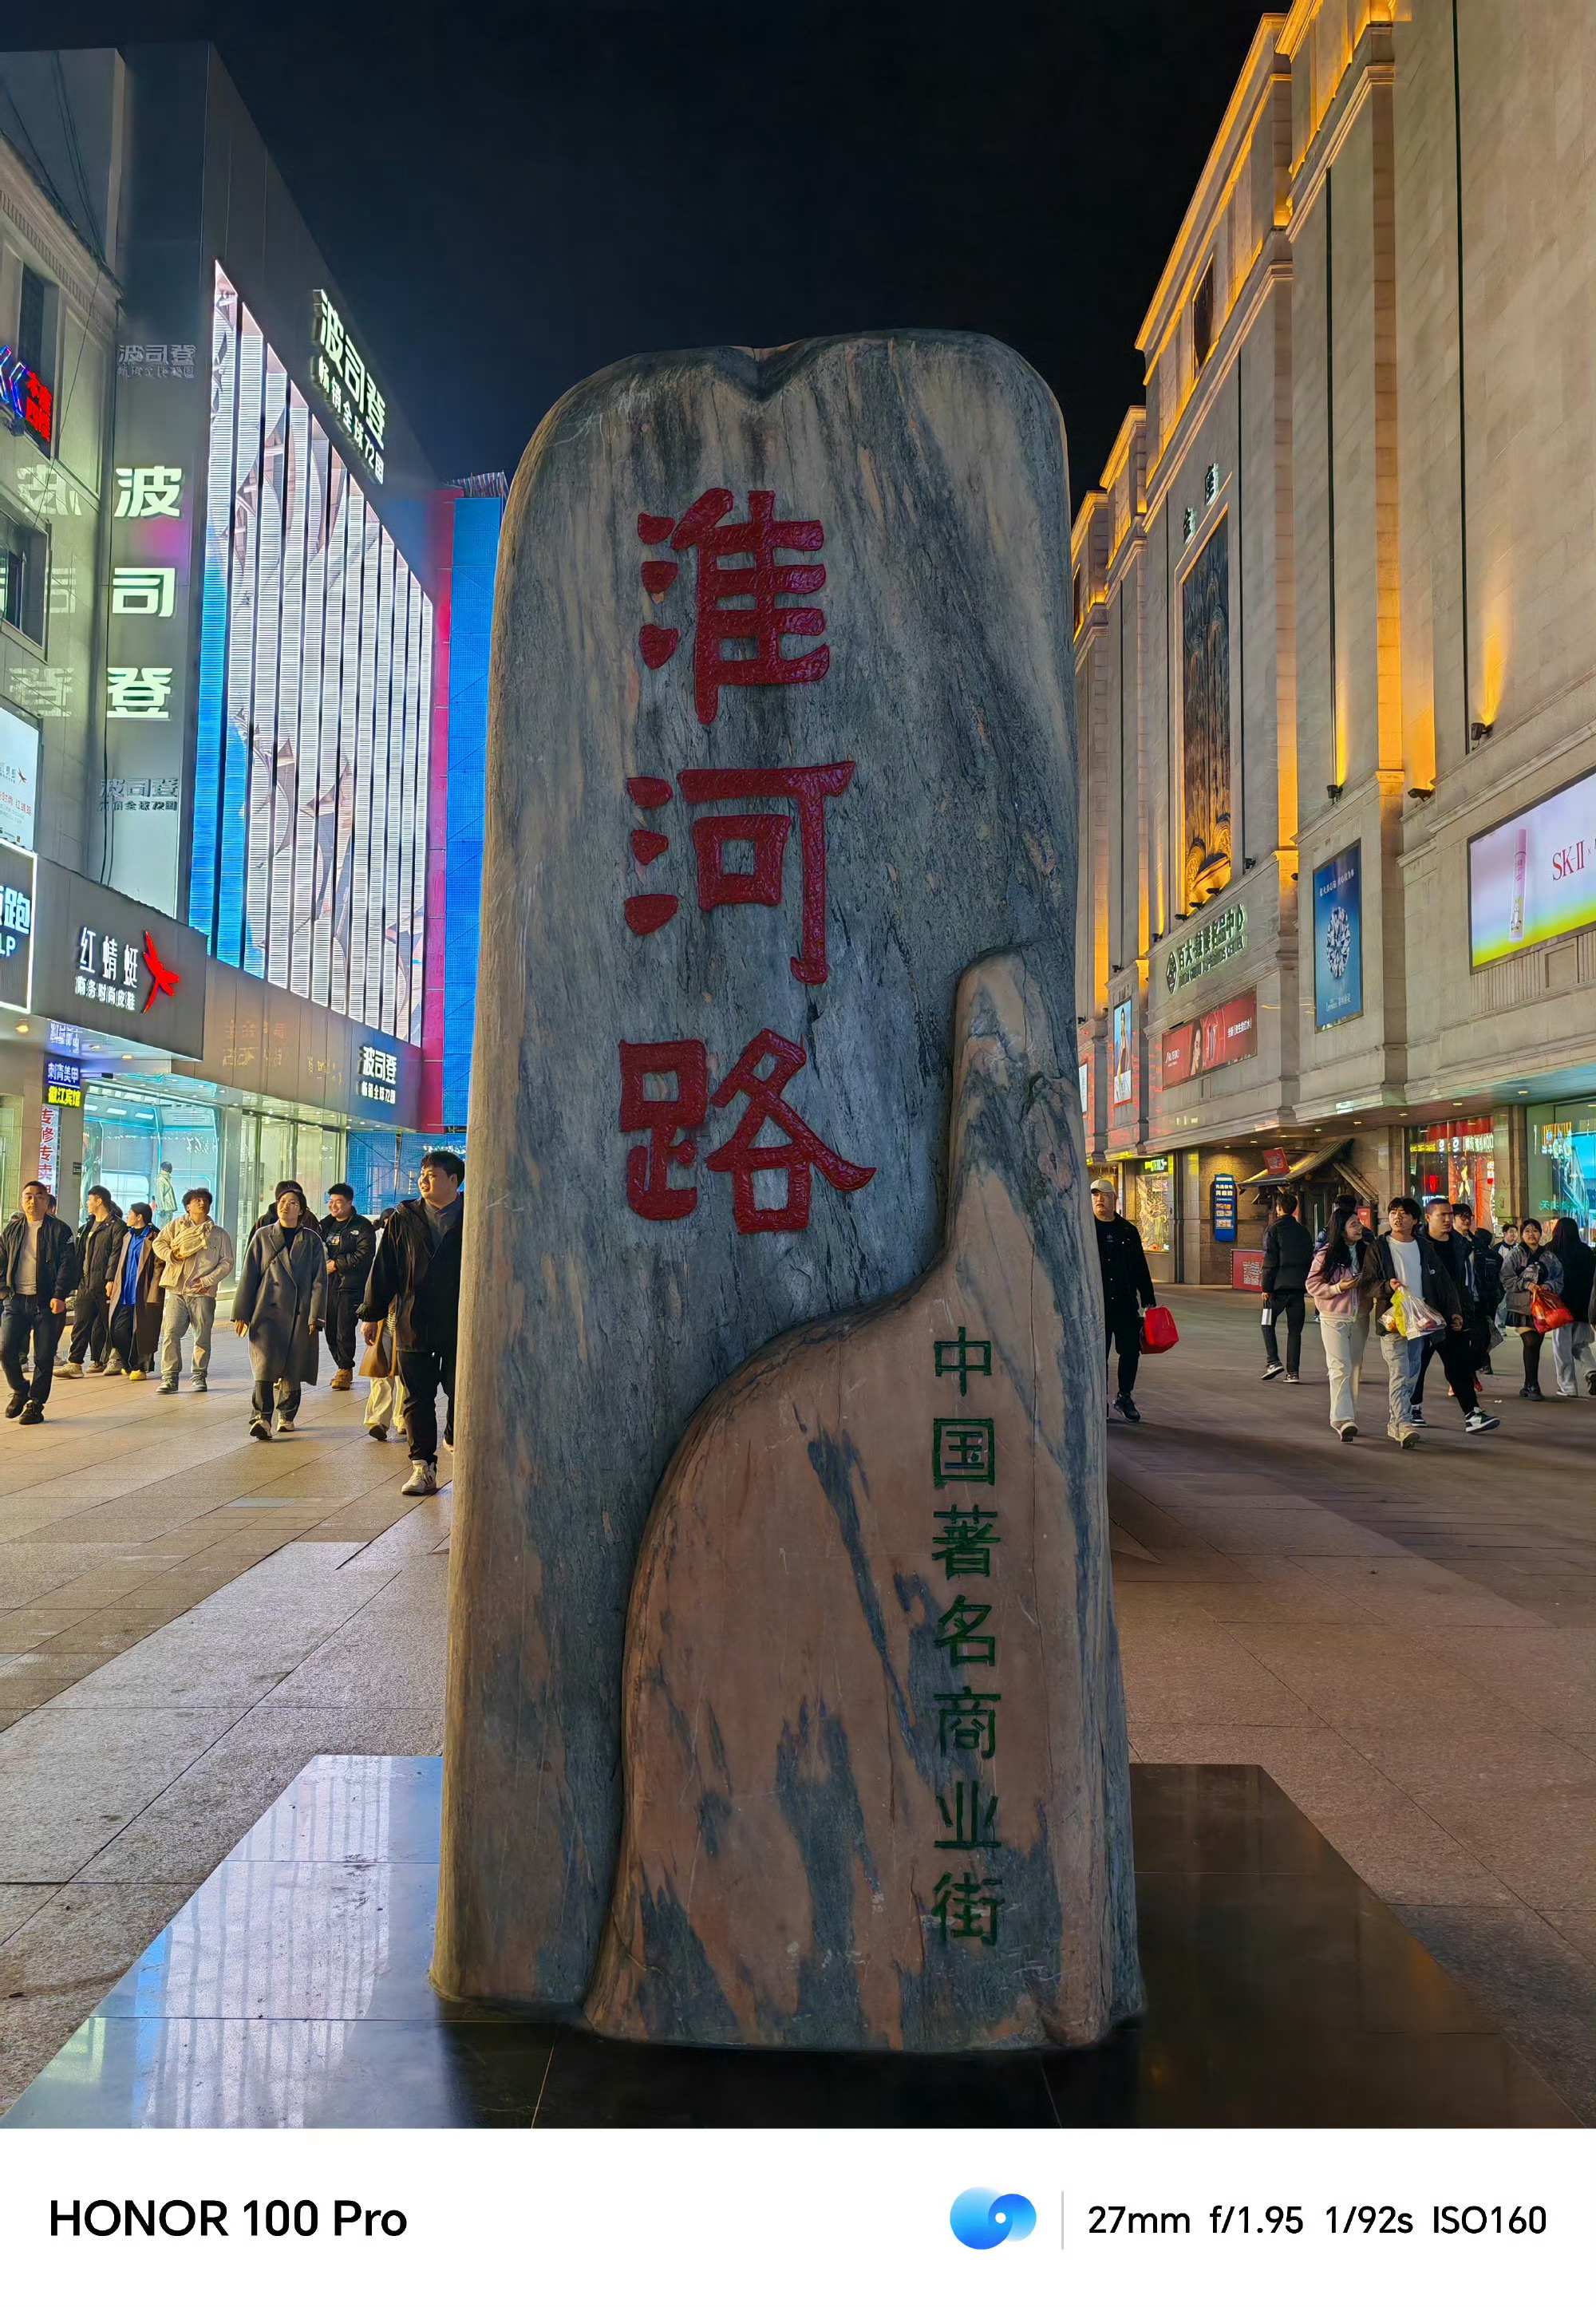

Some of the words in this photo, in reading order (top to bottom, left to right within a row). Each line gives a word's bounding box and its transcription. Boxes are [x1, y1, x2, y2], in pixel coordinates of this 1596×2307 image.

[320, 289, 385, 450] 波司登
[107, 466, 183, 718] 波司登
[0, 886, 31, 934] 跑
[619, 488, 876, 1234] 淮河路
[1552, 839, 1585, 881] SK-II
[80, 926, 139, 988] 红蜻蜓
[362, 1046, 397, 1084] 波司登
[932, 1326, 1005, 1946] 中国著名商业街
